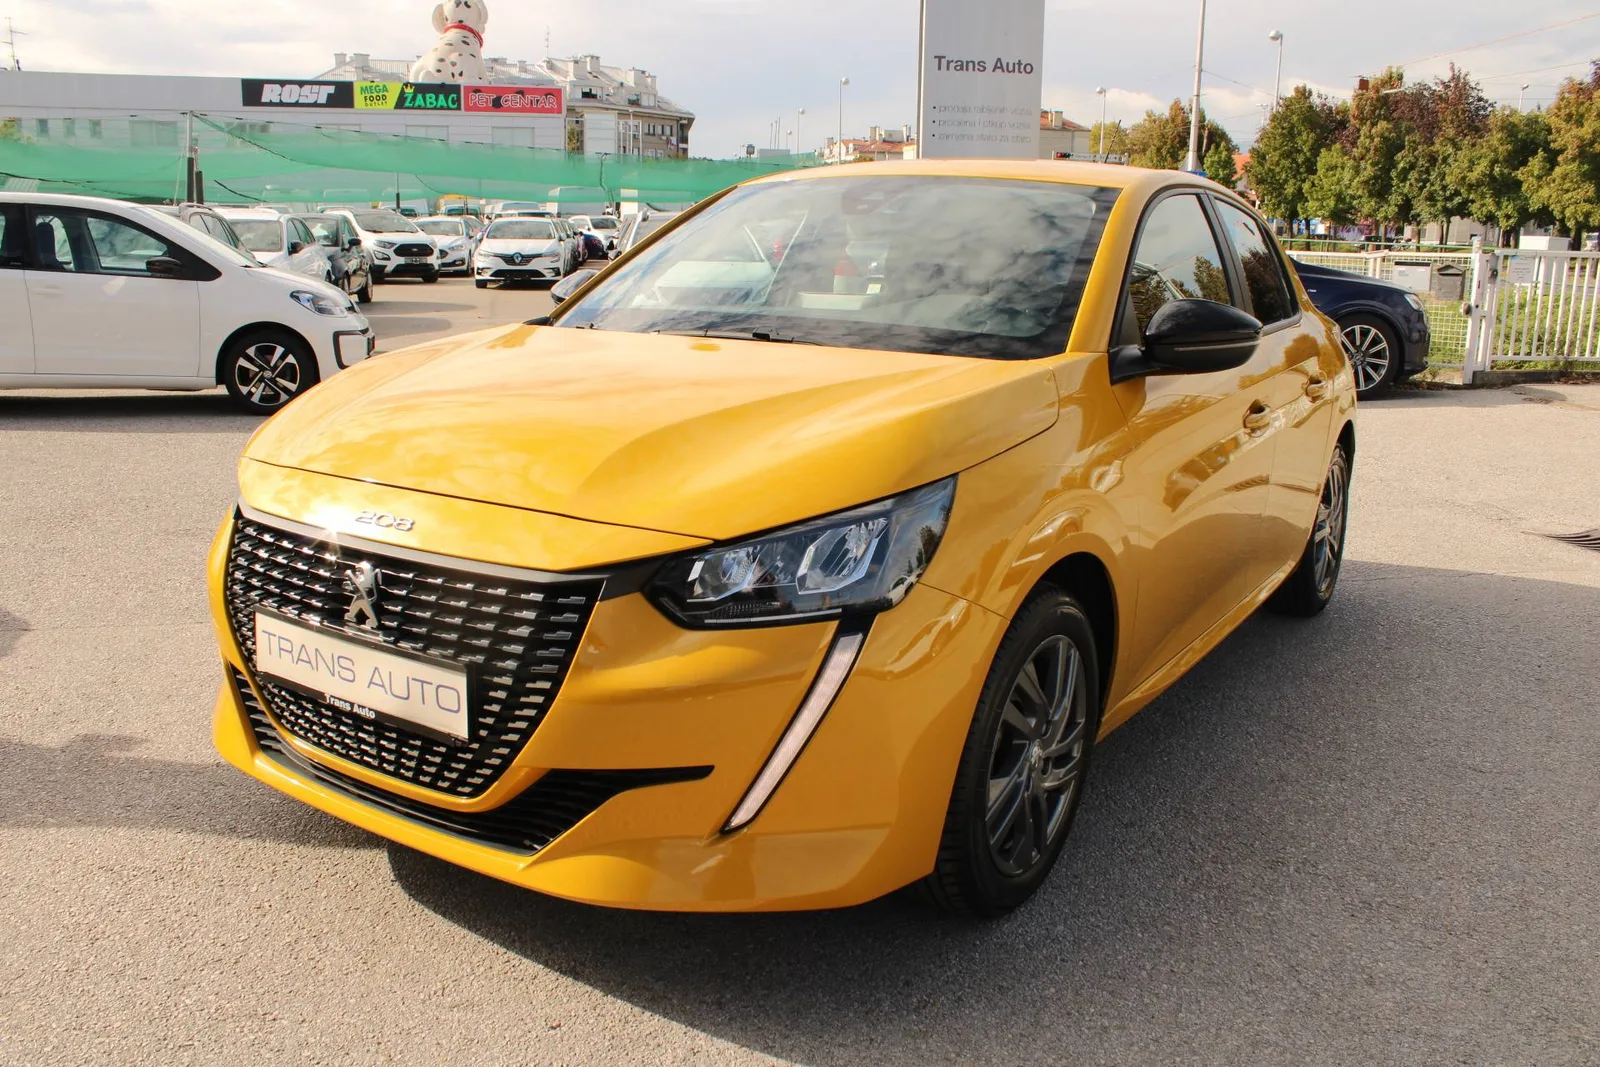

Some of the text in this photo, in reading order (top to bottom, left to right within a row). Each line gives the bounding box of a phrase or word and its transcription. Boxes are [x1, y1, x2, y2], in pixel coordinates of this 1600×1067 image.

[933, 55, 1034, 75] Trans Auto
[261, 83, 335, 104] ROST
[360, 84, 389, 95] MEGA
[363, 94, 387, 102] FOOD
[469, 93, 558, 109] PET CENTAR
[354, 510, 415, 532] 208
[262, 630, 461, 714] TRANS AUTO
[324, 693, 376, 719] Trans Auto
